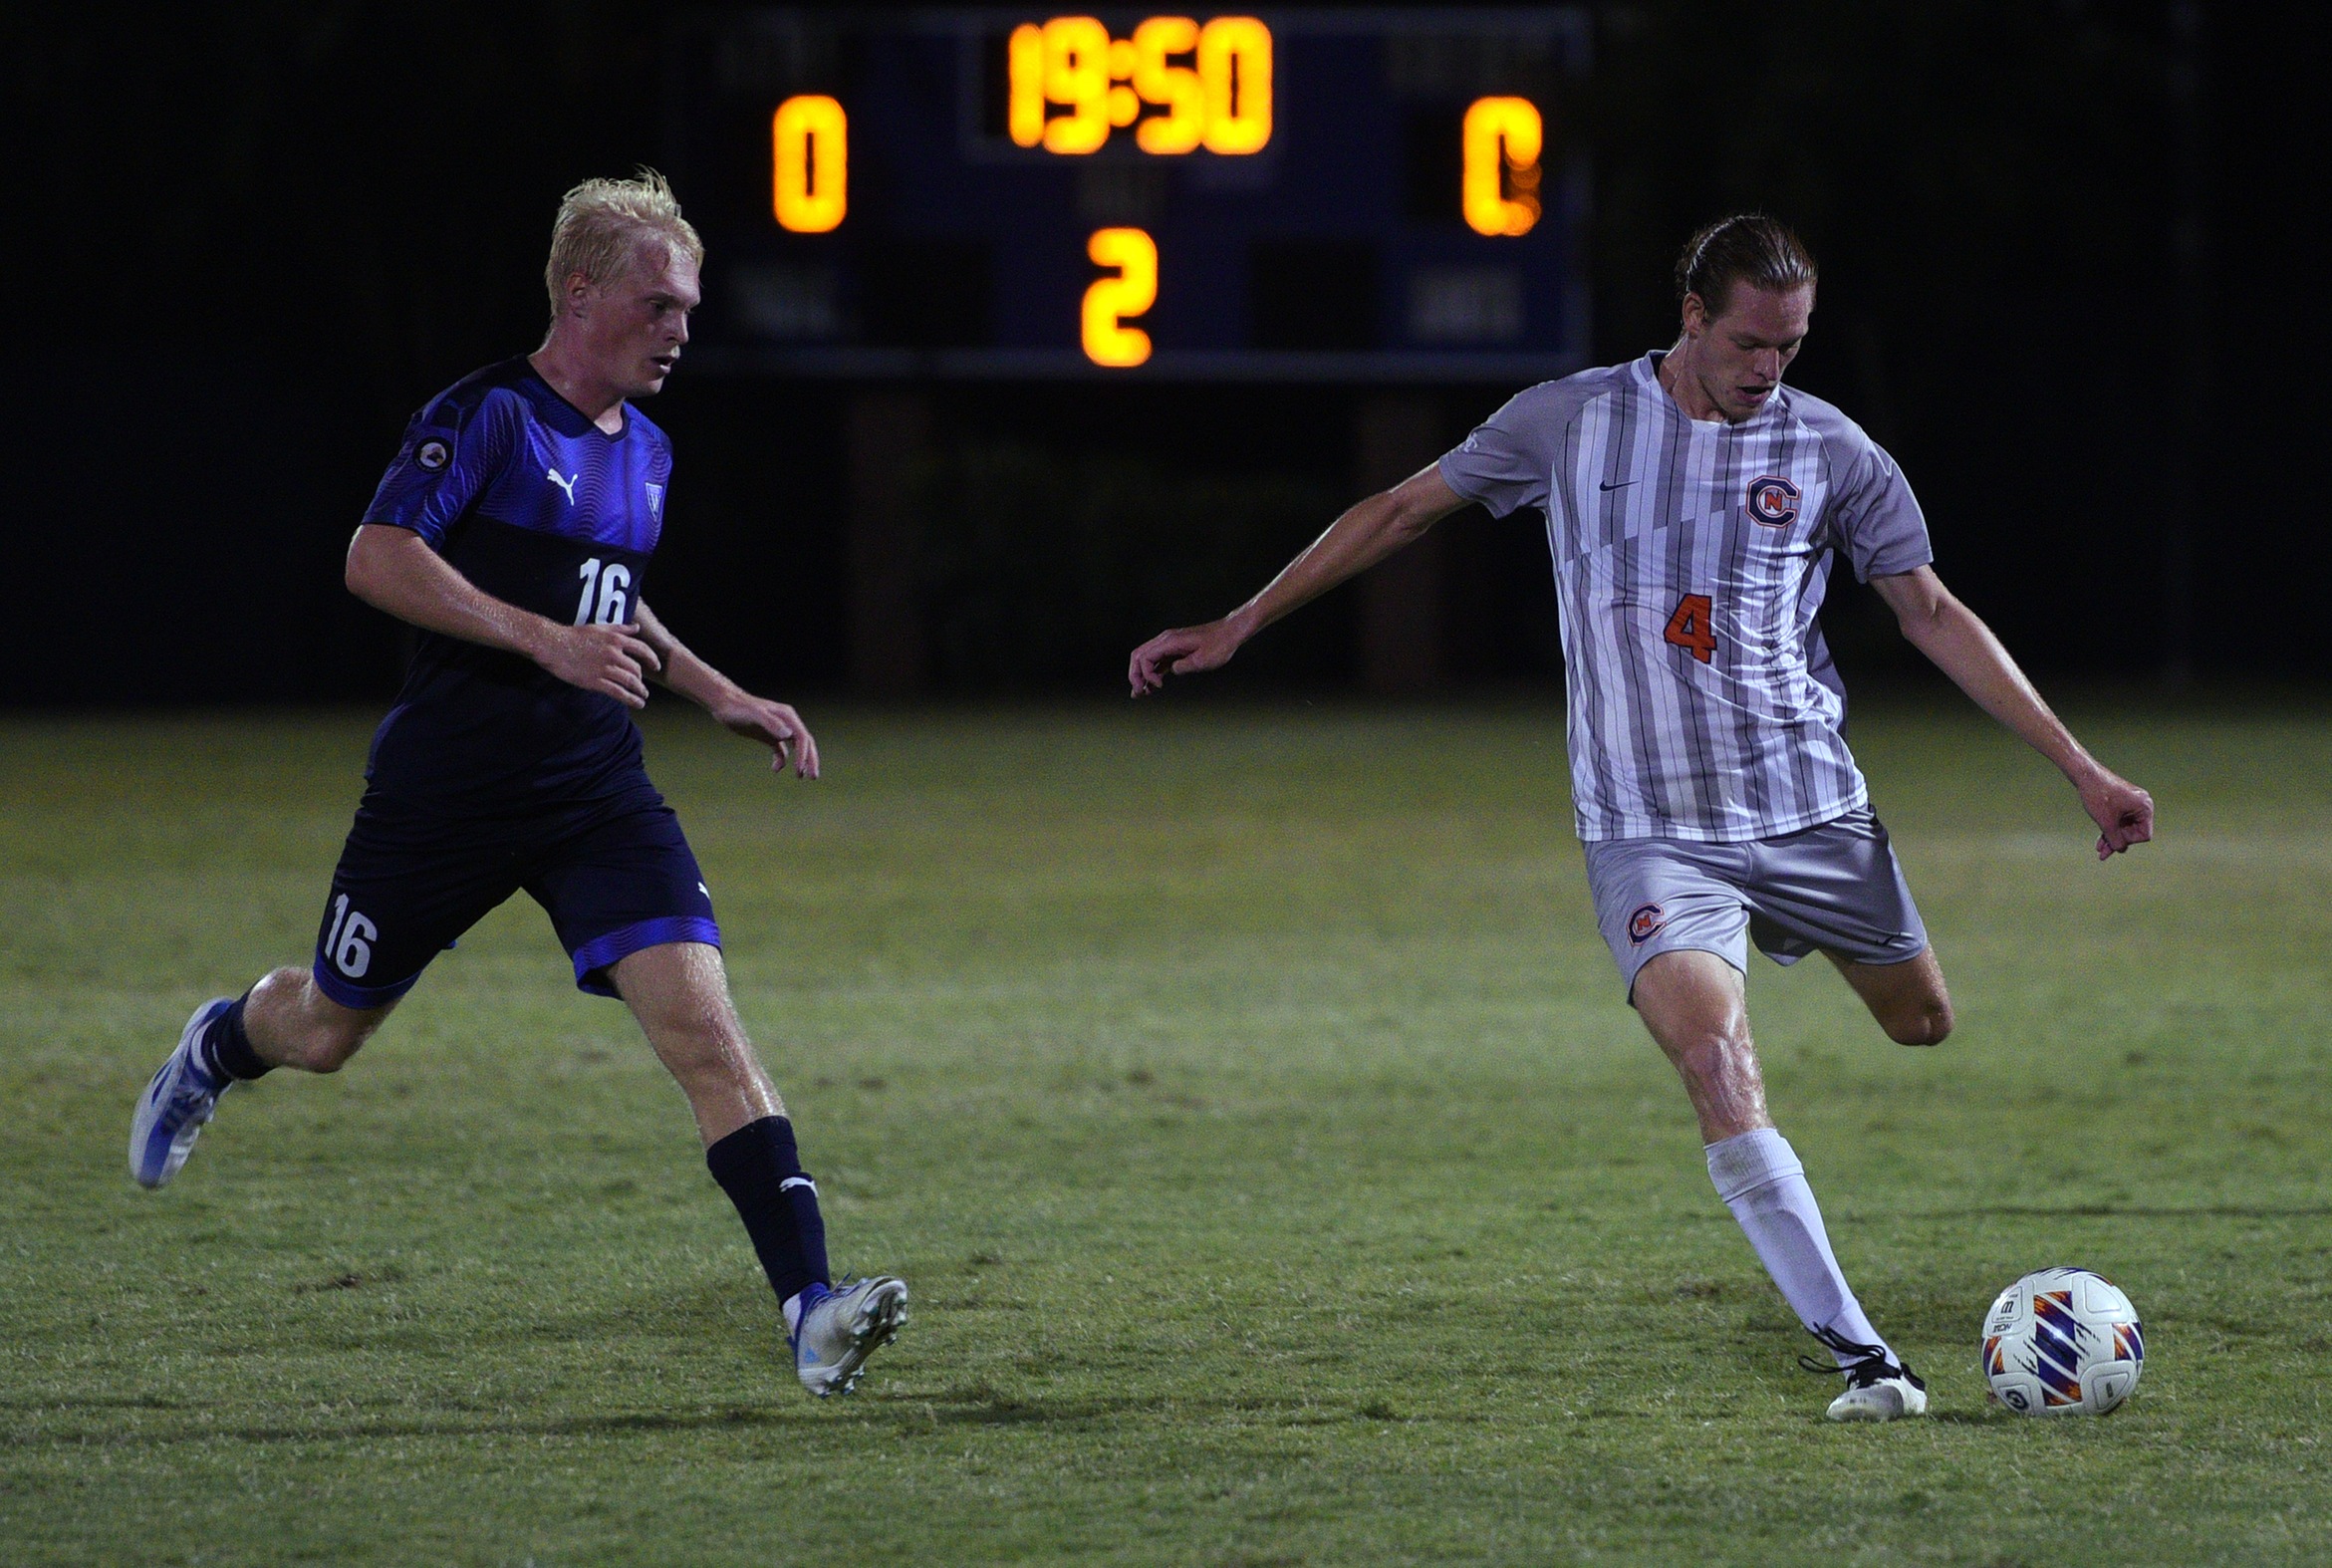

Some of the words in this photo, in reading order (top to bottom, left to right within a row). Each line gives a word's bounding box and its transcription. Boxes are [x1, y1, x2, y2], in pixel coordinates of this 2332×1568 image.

[1008, 15, 1273, 155] 19:50
[772, 94, 848, 234] 0
[1080, 226, 1159, 369] 2
[574, 557, 631, 626] 16
[1663, 593, 1717, 664] 4
[325, 893, 378, 978] 16
